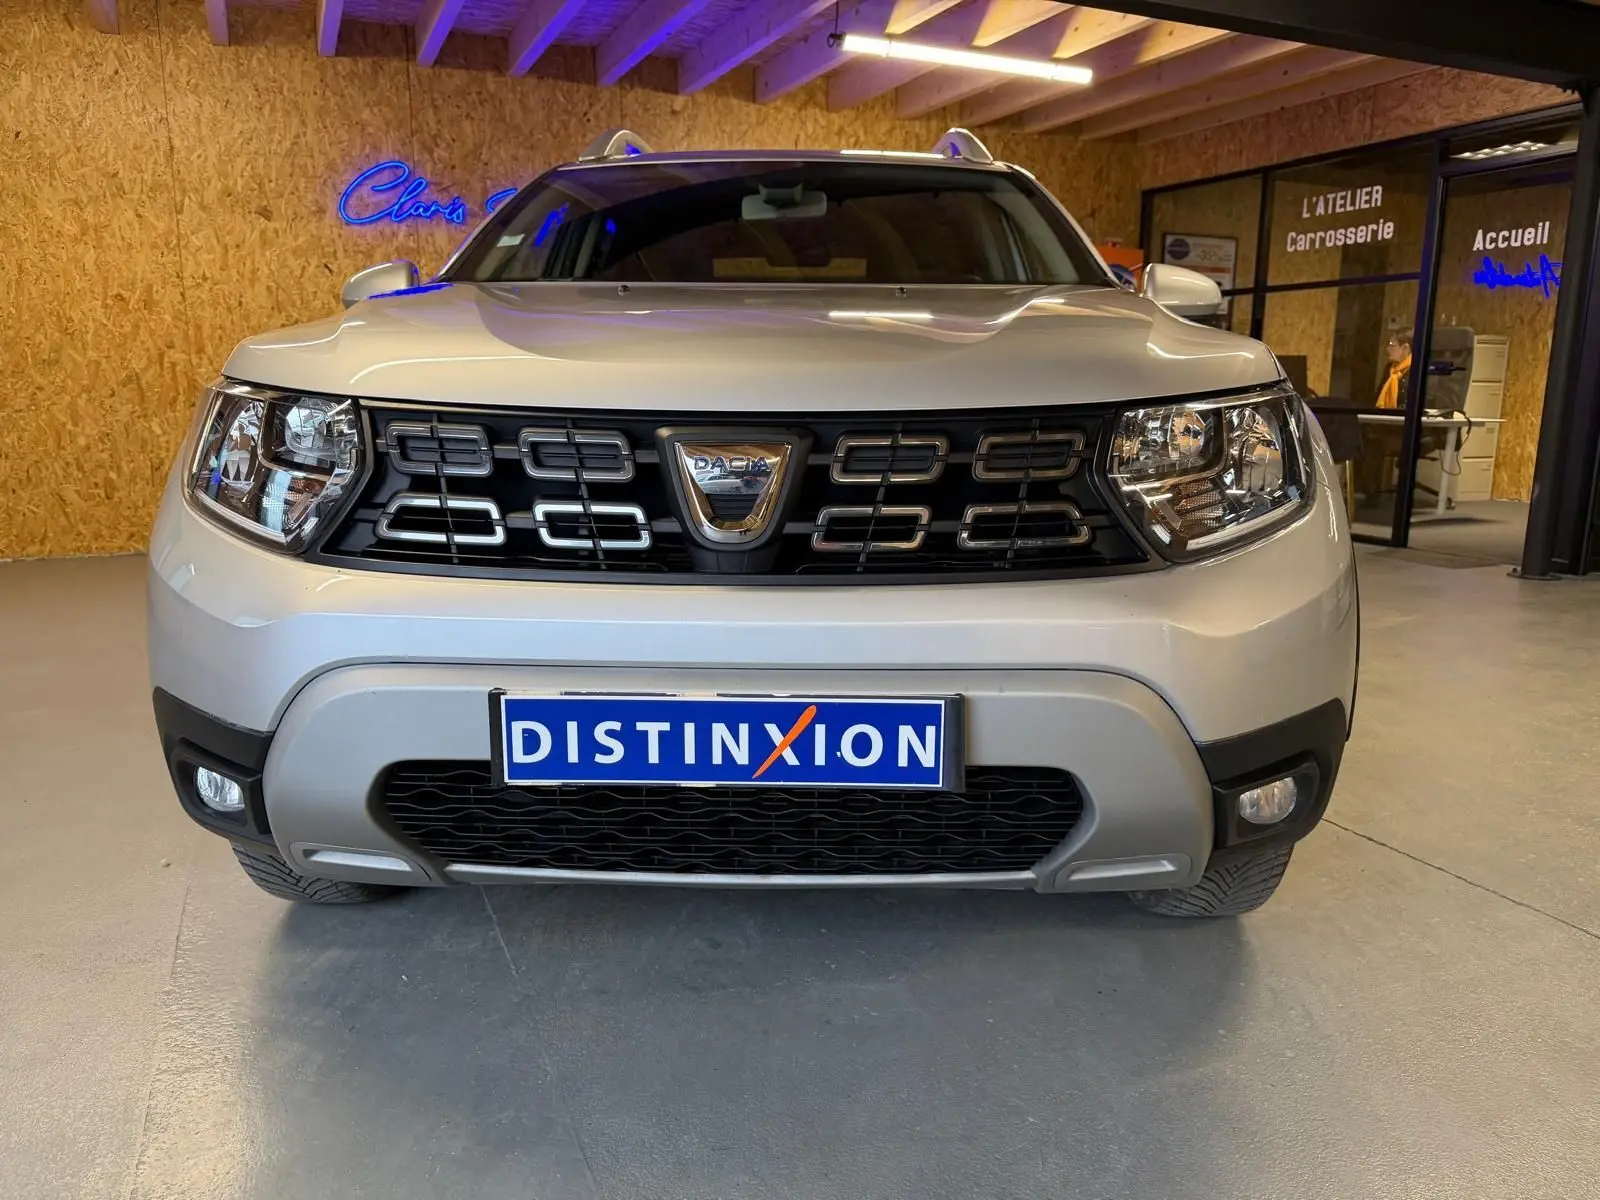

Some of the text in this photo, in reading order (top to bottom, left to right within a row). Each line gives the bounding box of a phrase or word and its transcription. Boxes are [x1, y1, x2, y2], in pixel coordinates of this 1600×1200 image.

[339, 160, 466, 225] Claris
[1302, 185, 1382, 218] L'ATELIER
[1286, 219, 1394, 252] Carrosserie
[1472, 221, 1550, 251] Accueil
[694, 456, 771, 472] DACIA
[511, 705, 937, 778] DISTINXION
